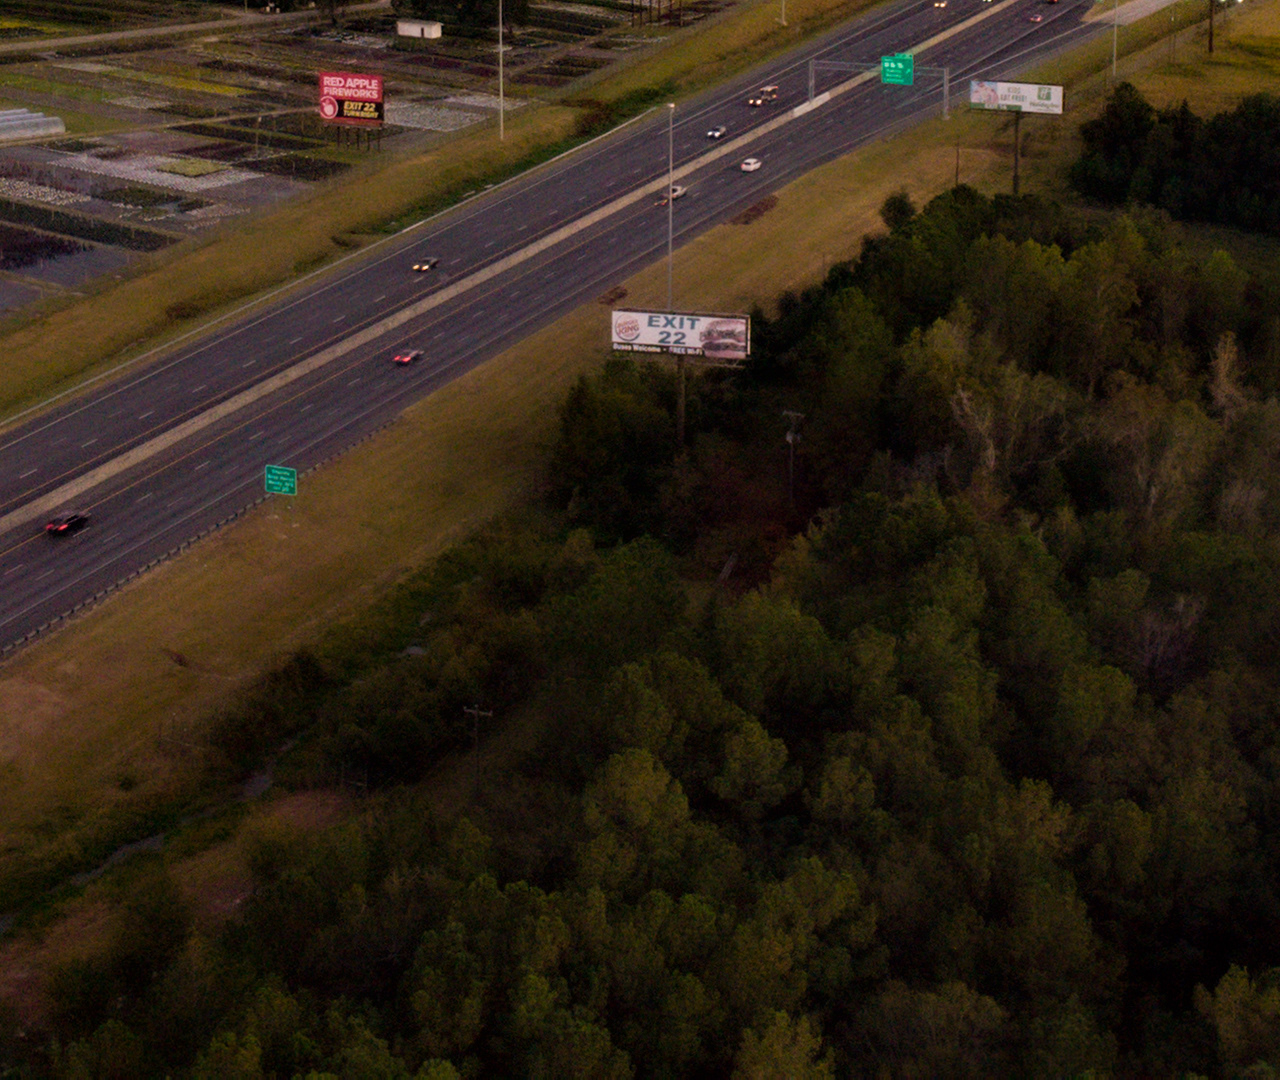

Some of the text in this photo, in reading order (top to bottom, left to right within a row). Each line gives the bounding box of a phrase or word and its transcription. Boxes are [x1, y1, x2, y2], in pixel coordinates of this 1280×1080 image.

[323, 76, 379, 90] RED APPLE
[323, 86, 379, 99] FIREWORKS
[343, 101, 376, 112] EXIT 22
[647, 315, 701, 330] EXIT
[658, 330, 687, 345] 22
